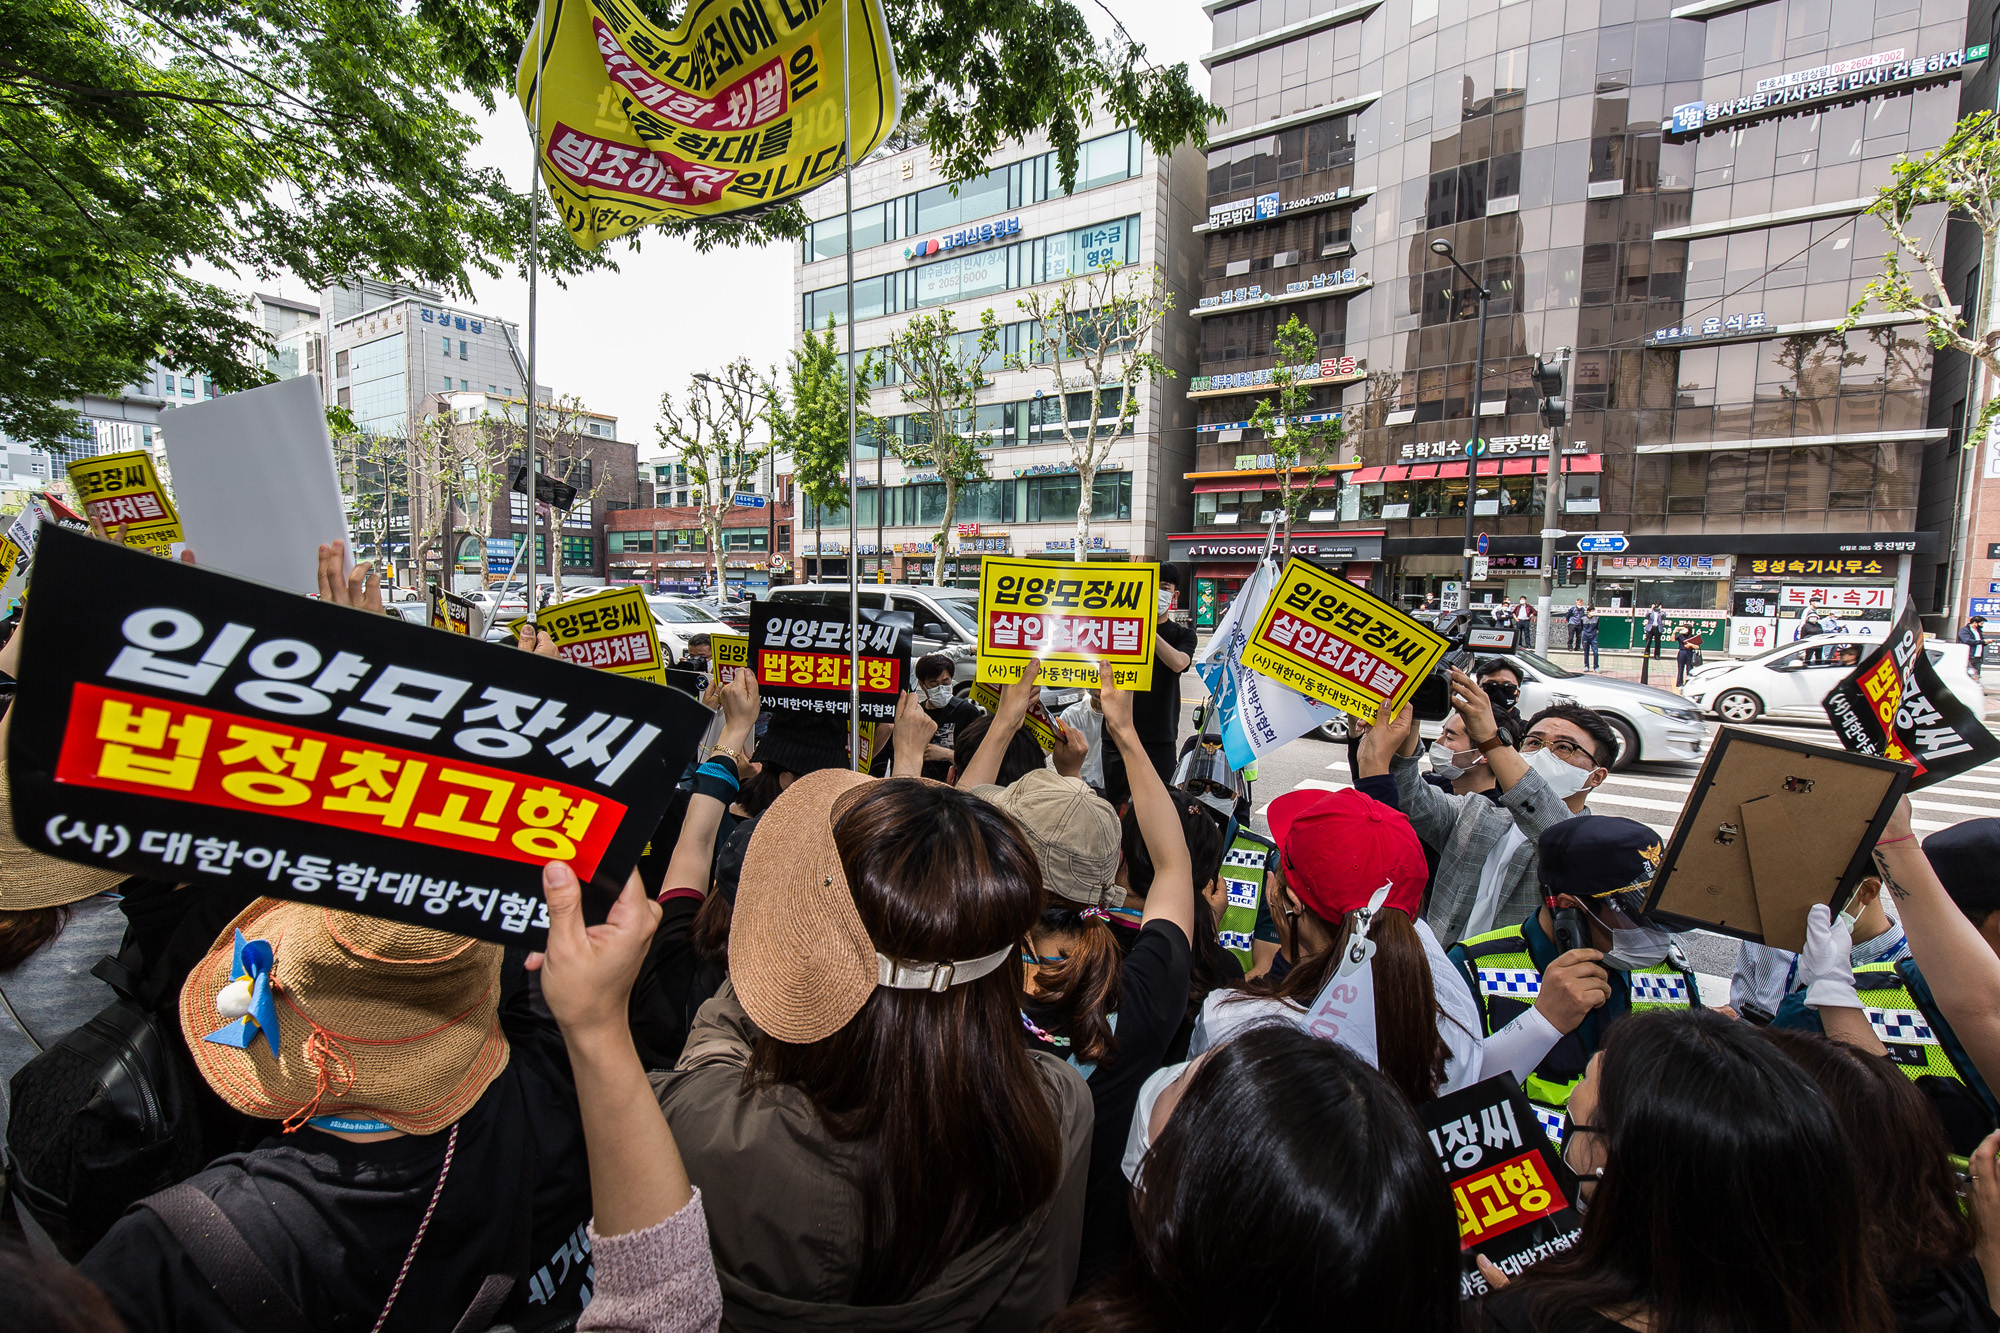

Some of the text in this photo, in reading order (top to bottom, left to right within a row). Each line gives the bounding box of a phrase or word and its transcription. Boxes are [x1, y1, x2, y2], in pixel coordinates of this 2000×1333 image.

[1758, 49, 1903, 91] 변호사 직접상담 02-2604-7002
[1674, 46, 1988, 131] 강함 형사전문 가사전문 민사 건물하자 6F
[1209, 206, 1255, 230] 법무법인
[1256, 197, 1279, 217] 강함
[1281, 191, 1336, 211] T.2604-7002
[941, 216, 1022, 251] 고려신용정보
[1081, 226, 1122, 249] 미수금
[1086, 247, 1115, 268] 영업
[962, 269, 988, 285] 6000
[1286, 268, 1356, 293] 변호사 남기헌
[1199, 295, 1219, 308] 변호사
[1221, 285, 1261, 303] 김형균
[420, 308, 483, 335] 진성빌딩
[1656, 325, 1694, 339] 변호사
[1702, 312, 1767, 334] 윤석표
[1320, 356, 1357, 377] 공증
[1400, 434, 1588, 460] 독학재수 돌풍학원 7F
[957, 523, 981, 536] 녹취
[1188, 546, 1197, 556] A
[1873, 541, 1917, 551] 동진빌딩
[1612, 557, 1651, 569] 법무사
[1751, 560, 1883, 574] 정성속기사무소
[994, 575, 1144, 611] 입양모장씨
[764, 617, 901, 655] 입양모장씨
[993, 614, 1140, 652] 살인죄처벌
[1283, 582, 1427, 668] 입양모장씨
[1251, 652, 1272, 670] (사)
[1268, 614, 1404, 697] 살인죄처벌
[763, 653, 892, 690] 법정최고형
[987, 664, 1138, 685] (사) 대아동학대방협회
[105, 607, 662, 787] 입양모장씨
[777, 698, 896, 718] 대한아동학대지협회
[1243, 707, 1262, 749] Association
[95, 699, 600, 863] 법정최고형
[44, 813, 132, 862] (사)
[1227, 895, 1254, 906] OLICE
